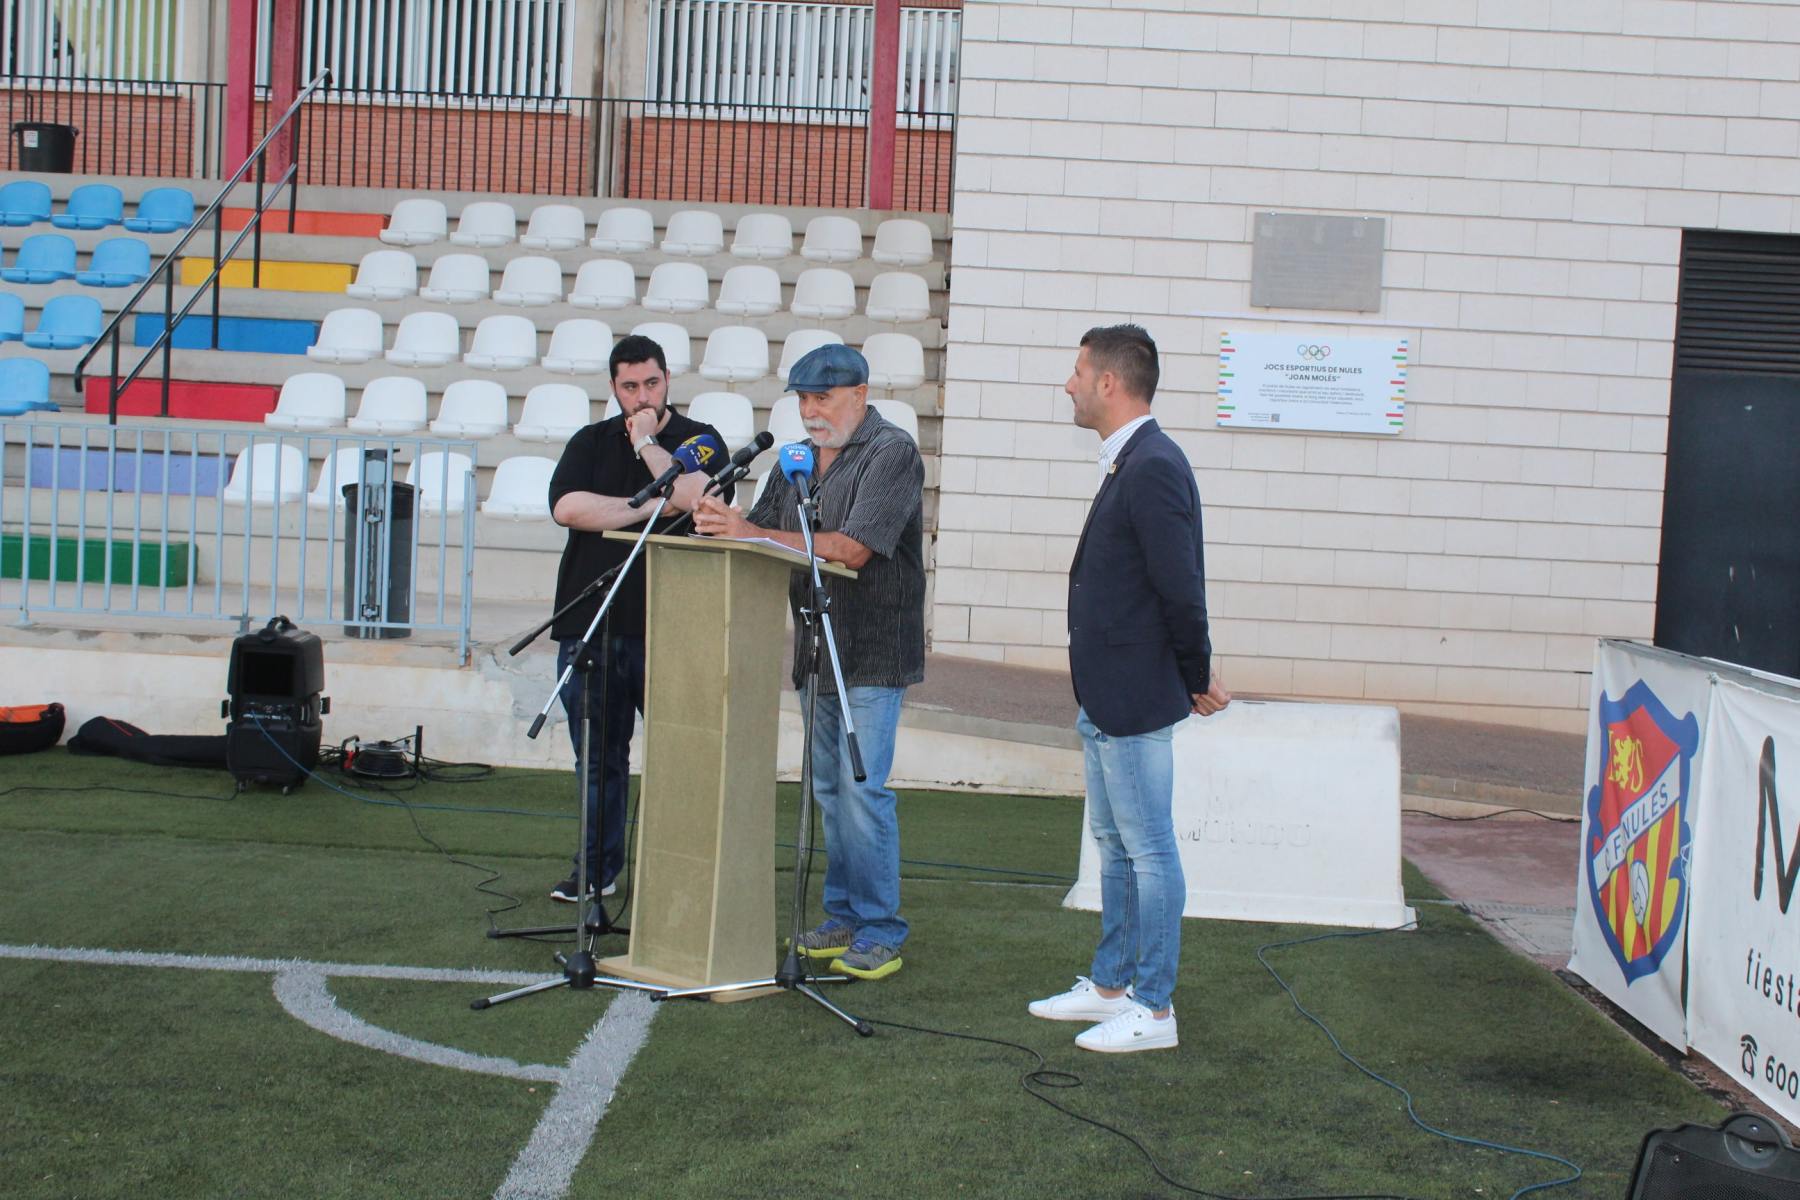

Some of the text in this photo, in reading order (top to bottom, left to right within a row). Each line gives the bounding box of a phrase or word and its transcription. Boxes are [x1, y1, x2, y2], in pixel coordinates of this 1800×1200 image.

[1264, 363, 1285, 371] JOCS
[1286, 364, 1327, 373] ESPORTIUS
[1622, 782, 1669, 841] NULES
[1765, 1055, 1799, 1100] 600
